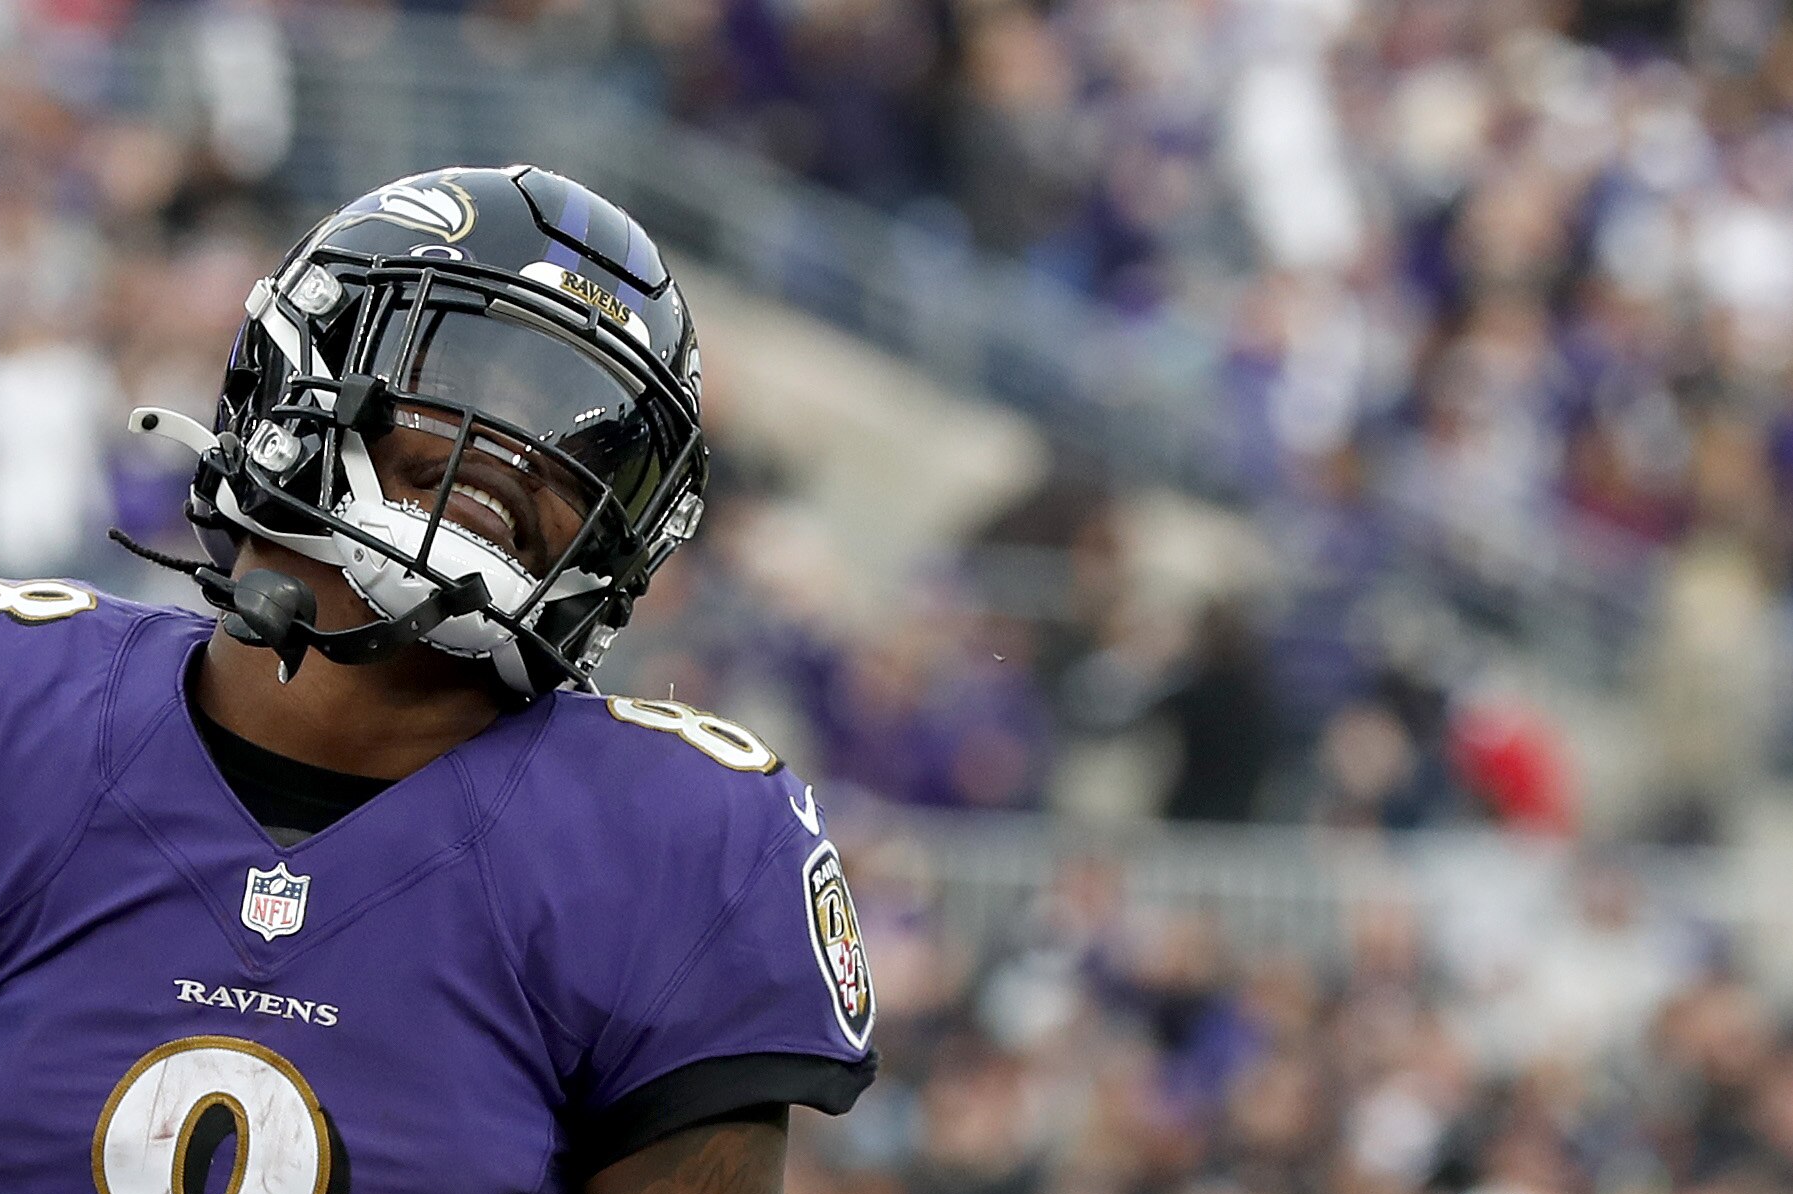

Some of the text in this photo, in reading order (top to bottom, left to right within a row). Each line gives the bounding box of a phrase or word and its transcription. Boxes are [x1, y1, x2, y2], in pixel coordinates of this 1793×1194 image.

[560, 270, 632, 326] RAVENS
[607, 695, 781, 775] 8
[251, 896, 294, 926] NFL
[173, 979, 340, 1027] RAVENS
